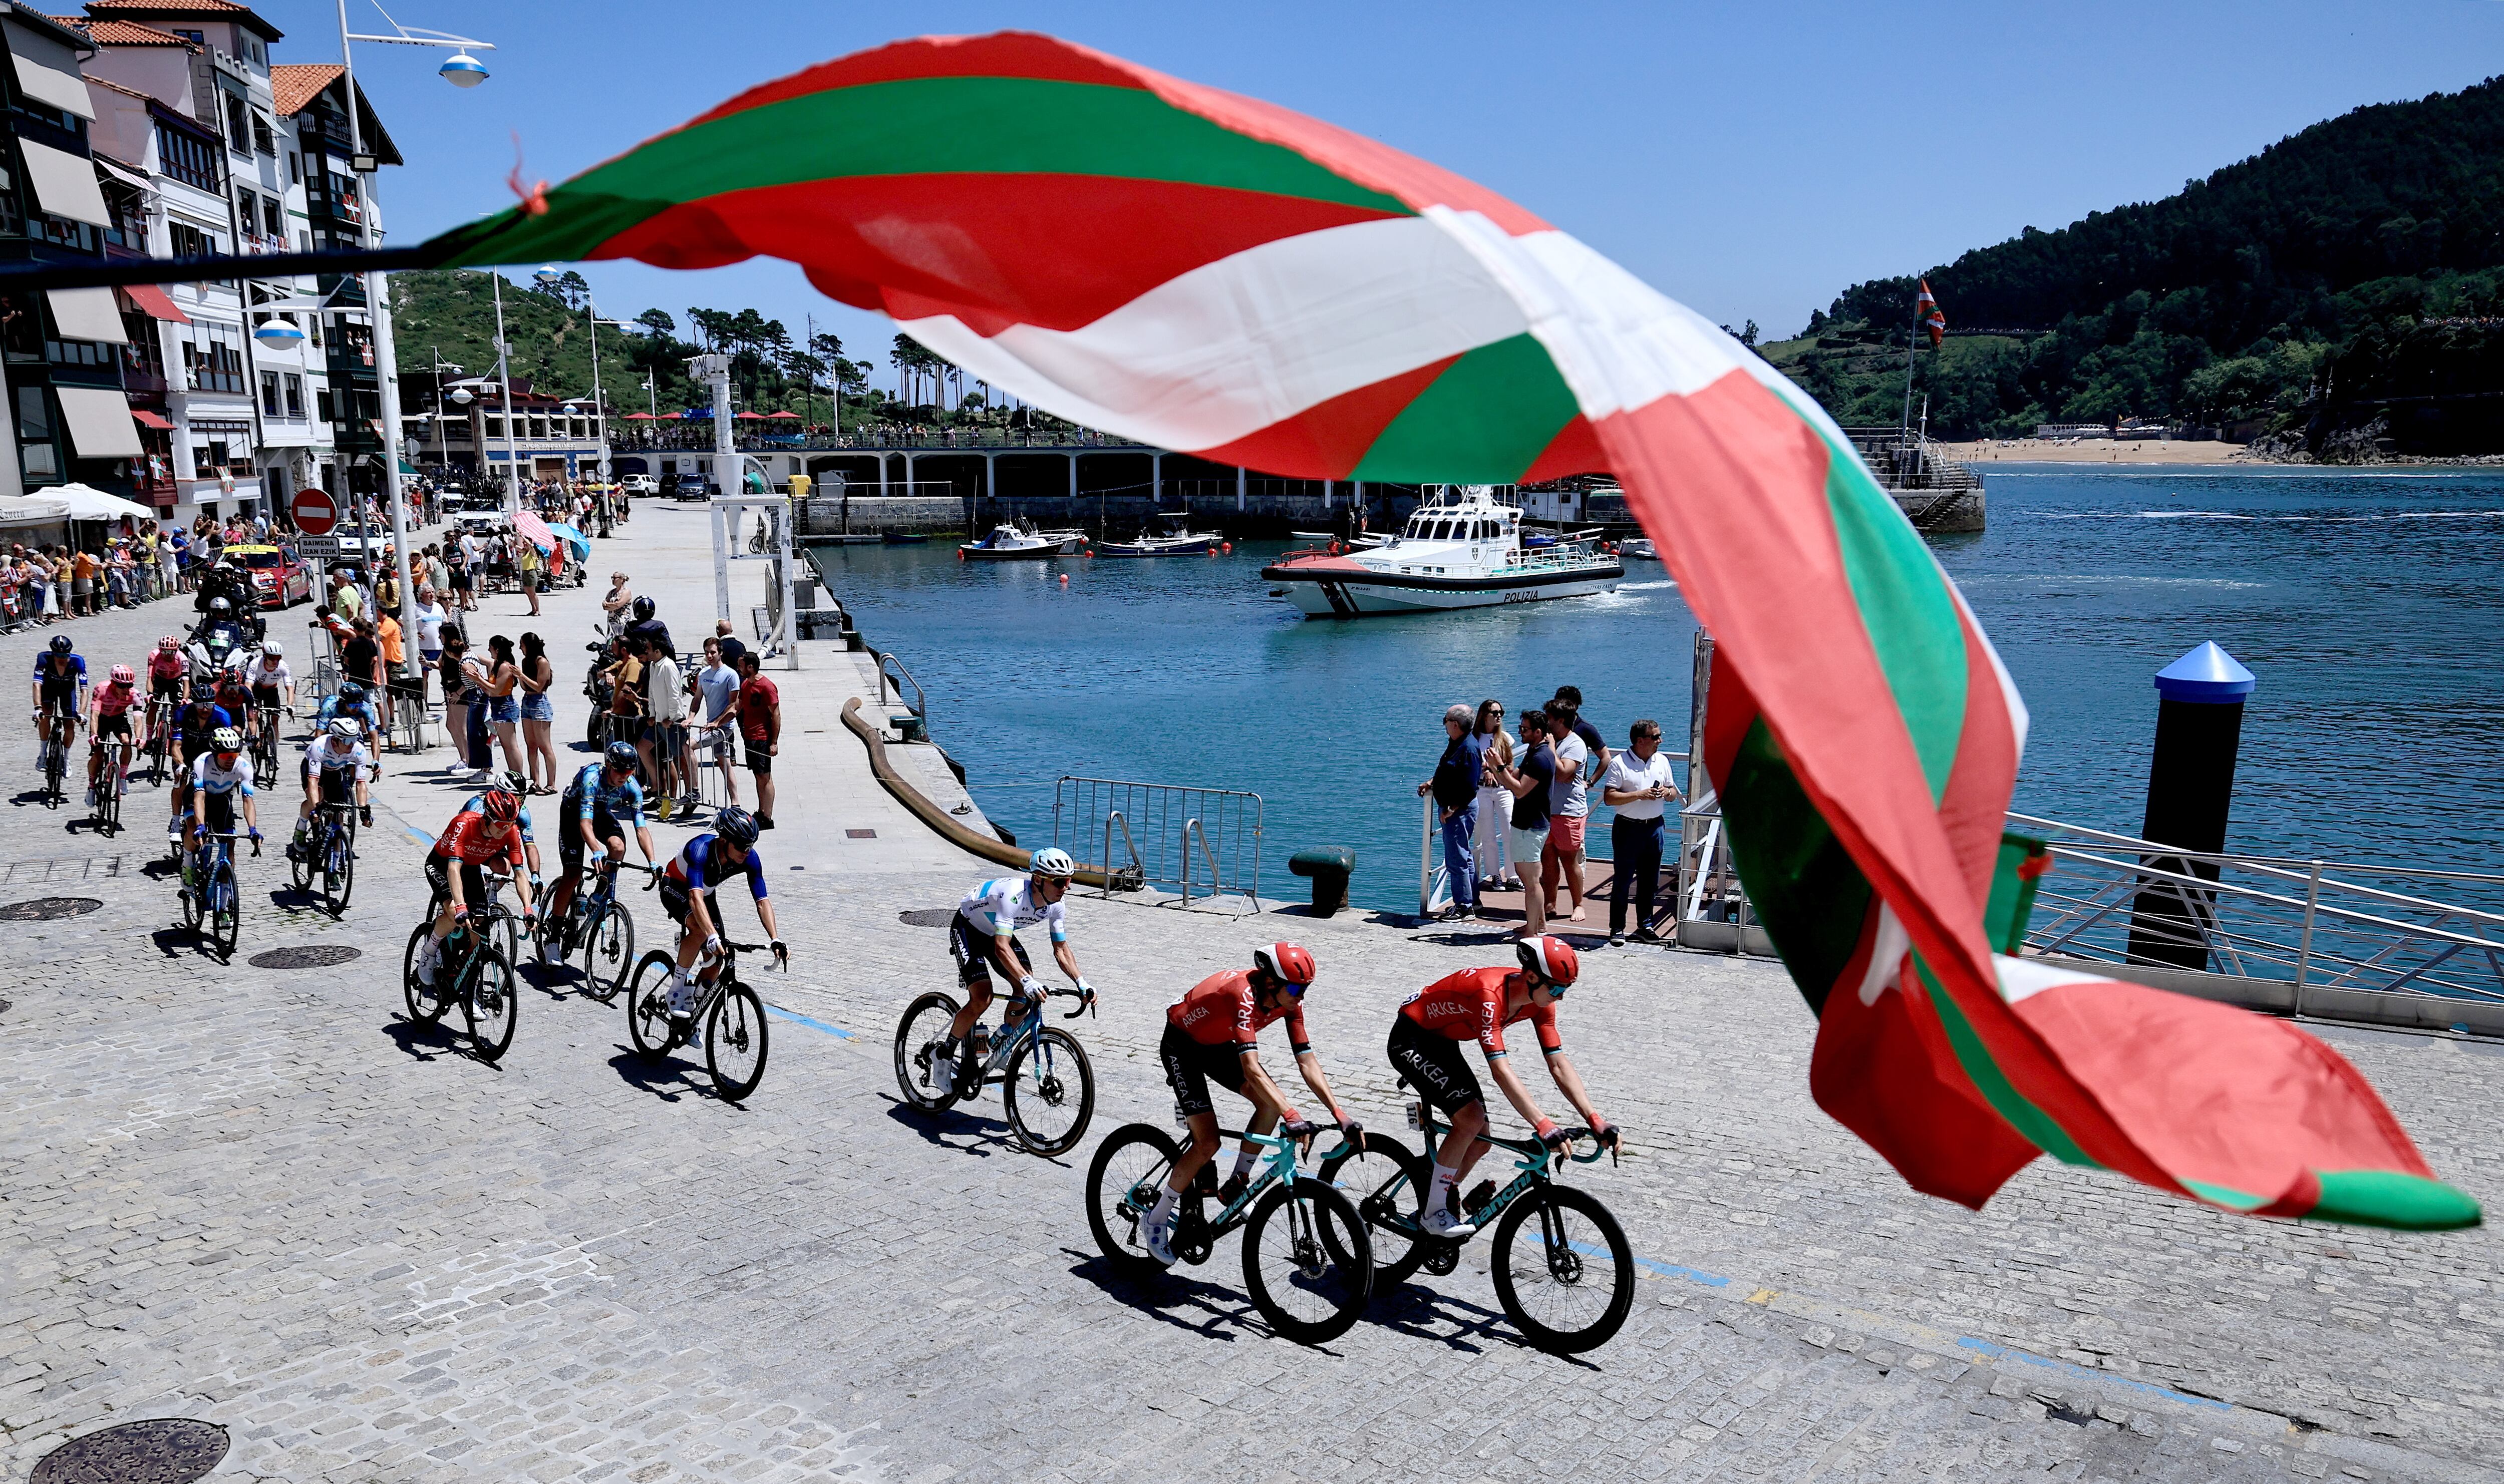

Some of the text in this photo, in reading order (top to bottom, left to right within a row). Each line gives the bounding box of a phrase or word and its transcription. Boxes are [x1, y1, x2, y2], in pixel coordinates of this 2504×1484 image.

[1504, 590, 1538, 602] POLIZIA
[449, 822, 466, 852] ARKEA
[464, 845, 497, 855] ARKEA
[426, 865, 447, 887] ARKEA
[664, 886, 687, 903] Groupama
[674, 936, 681, 946] 35
[953, 928, 970, 965] ASTANA
[690, 978, 721, 1024] LAPIERRE
[1427, 1002, 1473, 1019] ARKEA
[1182, 1006, 1210, 1028] ARKEA
[1481, 1001, 1496, 1045] ARKEA
[1169, 1055, 1188, 1098] ARKEA
[1400, 1050, 1449, 1089] ARKEA
[1406, 1106, 1418, 1125] 176
[1467, 1172, 1531, 1227] ianchi
